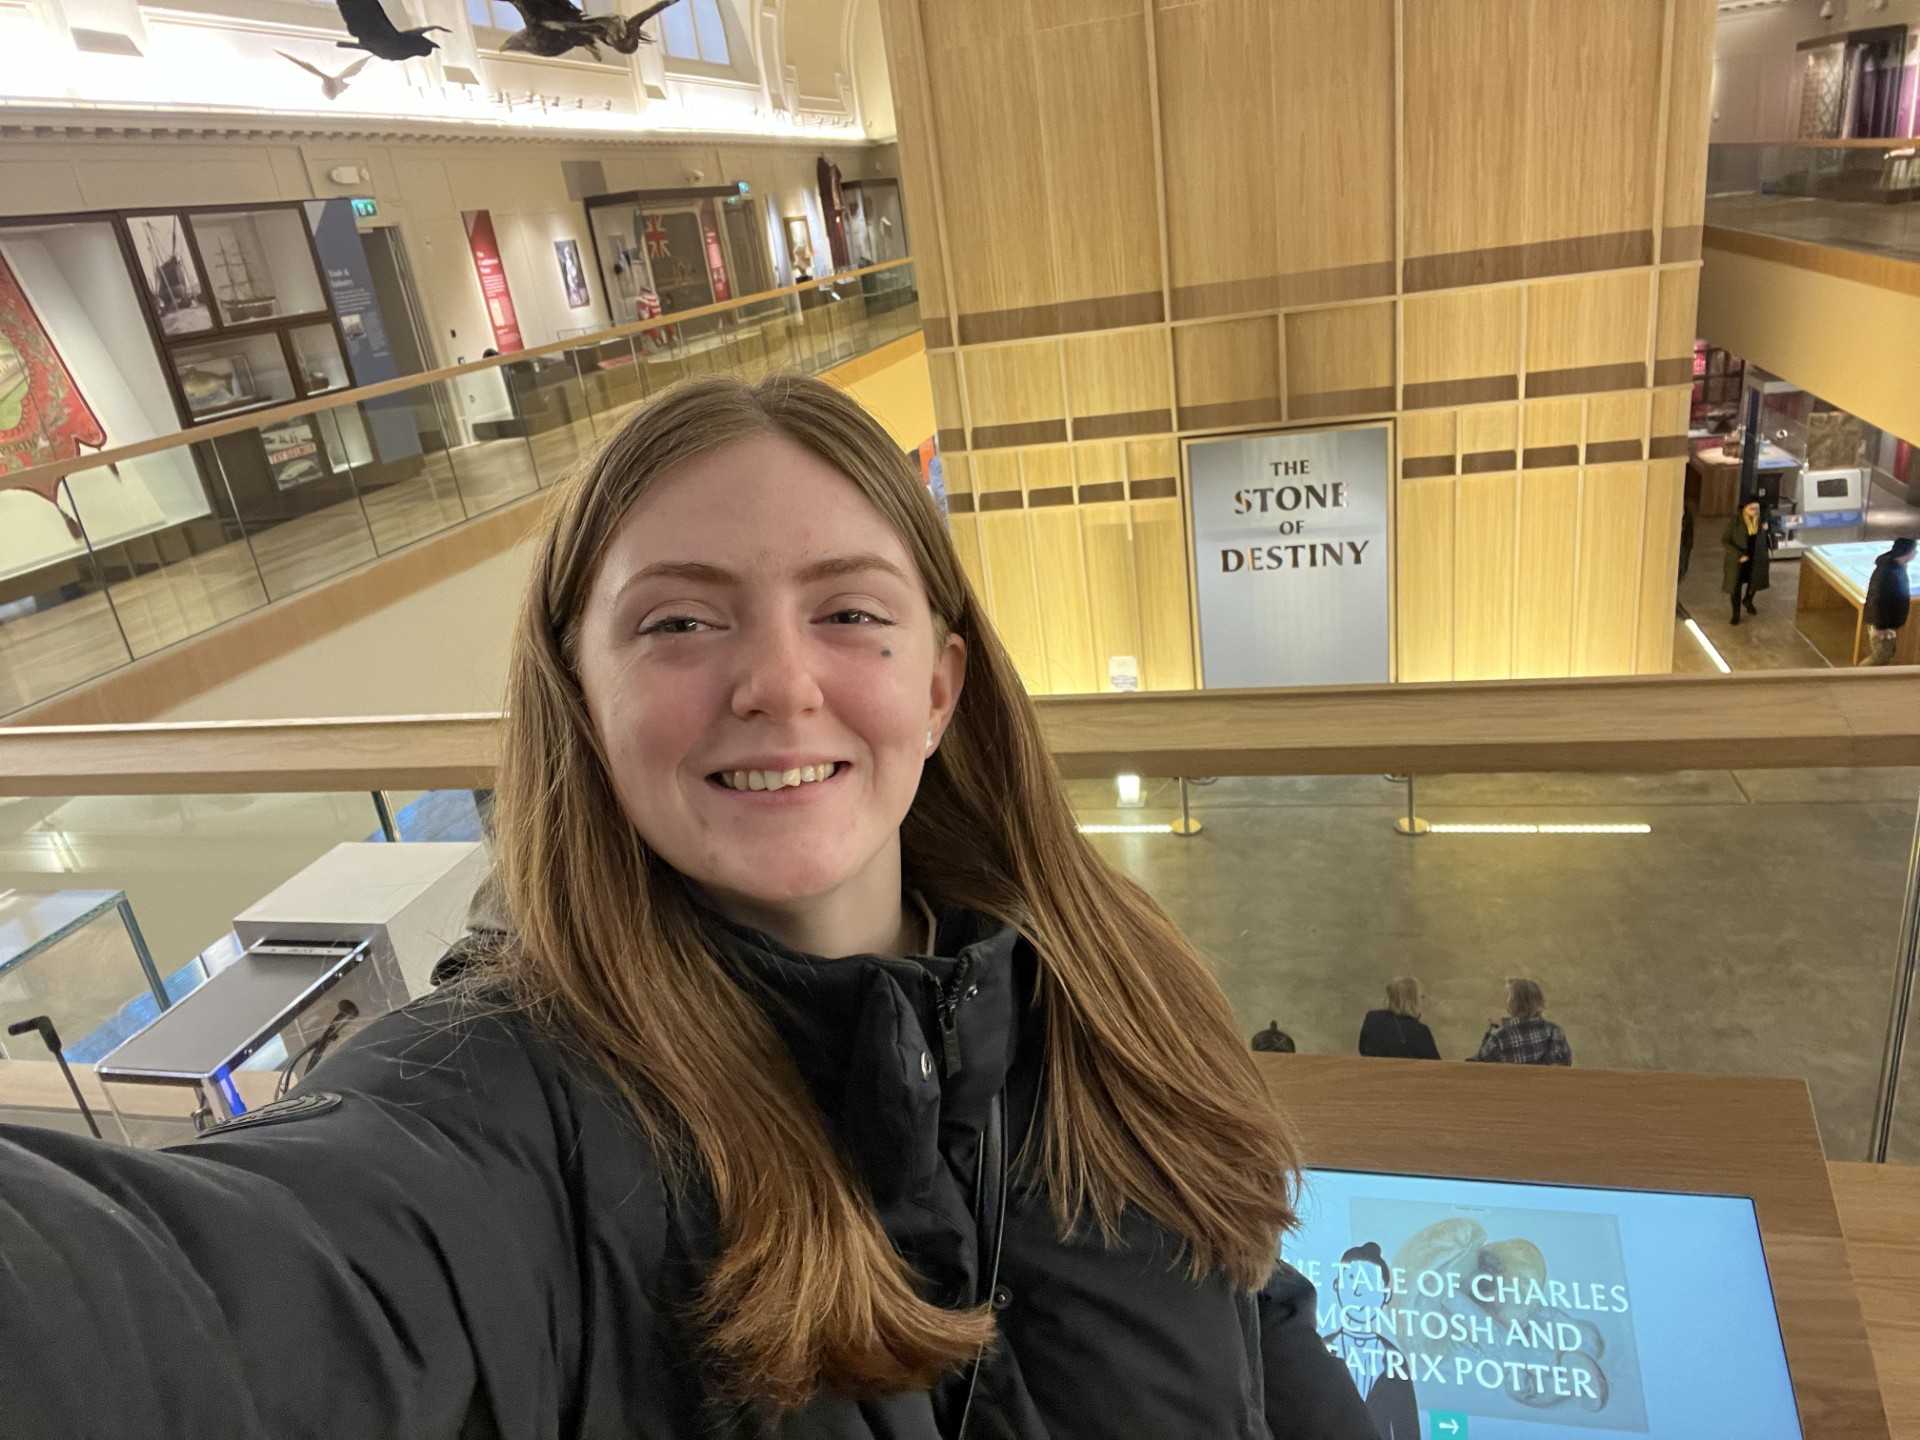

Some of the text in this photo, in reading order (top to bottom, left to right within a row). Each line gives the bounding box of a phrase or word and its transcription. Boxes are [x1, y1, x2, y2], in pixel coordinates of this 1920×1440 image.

[1270, 460, 1311, 477] THE
[1234, 481, 1348, 515] STONE
[1279, 520, 1305, 535] OF
[1221, 540, 1370, 573] DESTINY
[1331, 1262, 1406, 1295] TALE
[1417, 1269, 1461, 1299] OF
[1471, 1273, 1630, 1314] CHARLES
[1316, 1302, 1583, 1353] MCINTOSH AND
[1327, 1344, 1597, 1399] ATRIX POTTER
